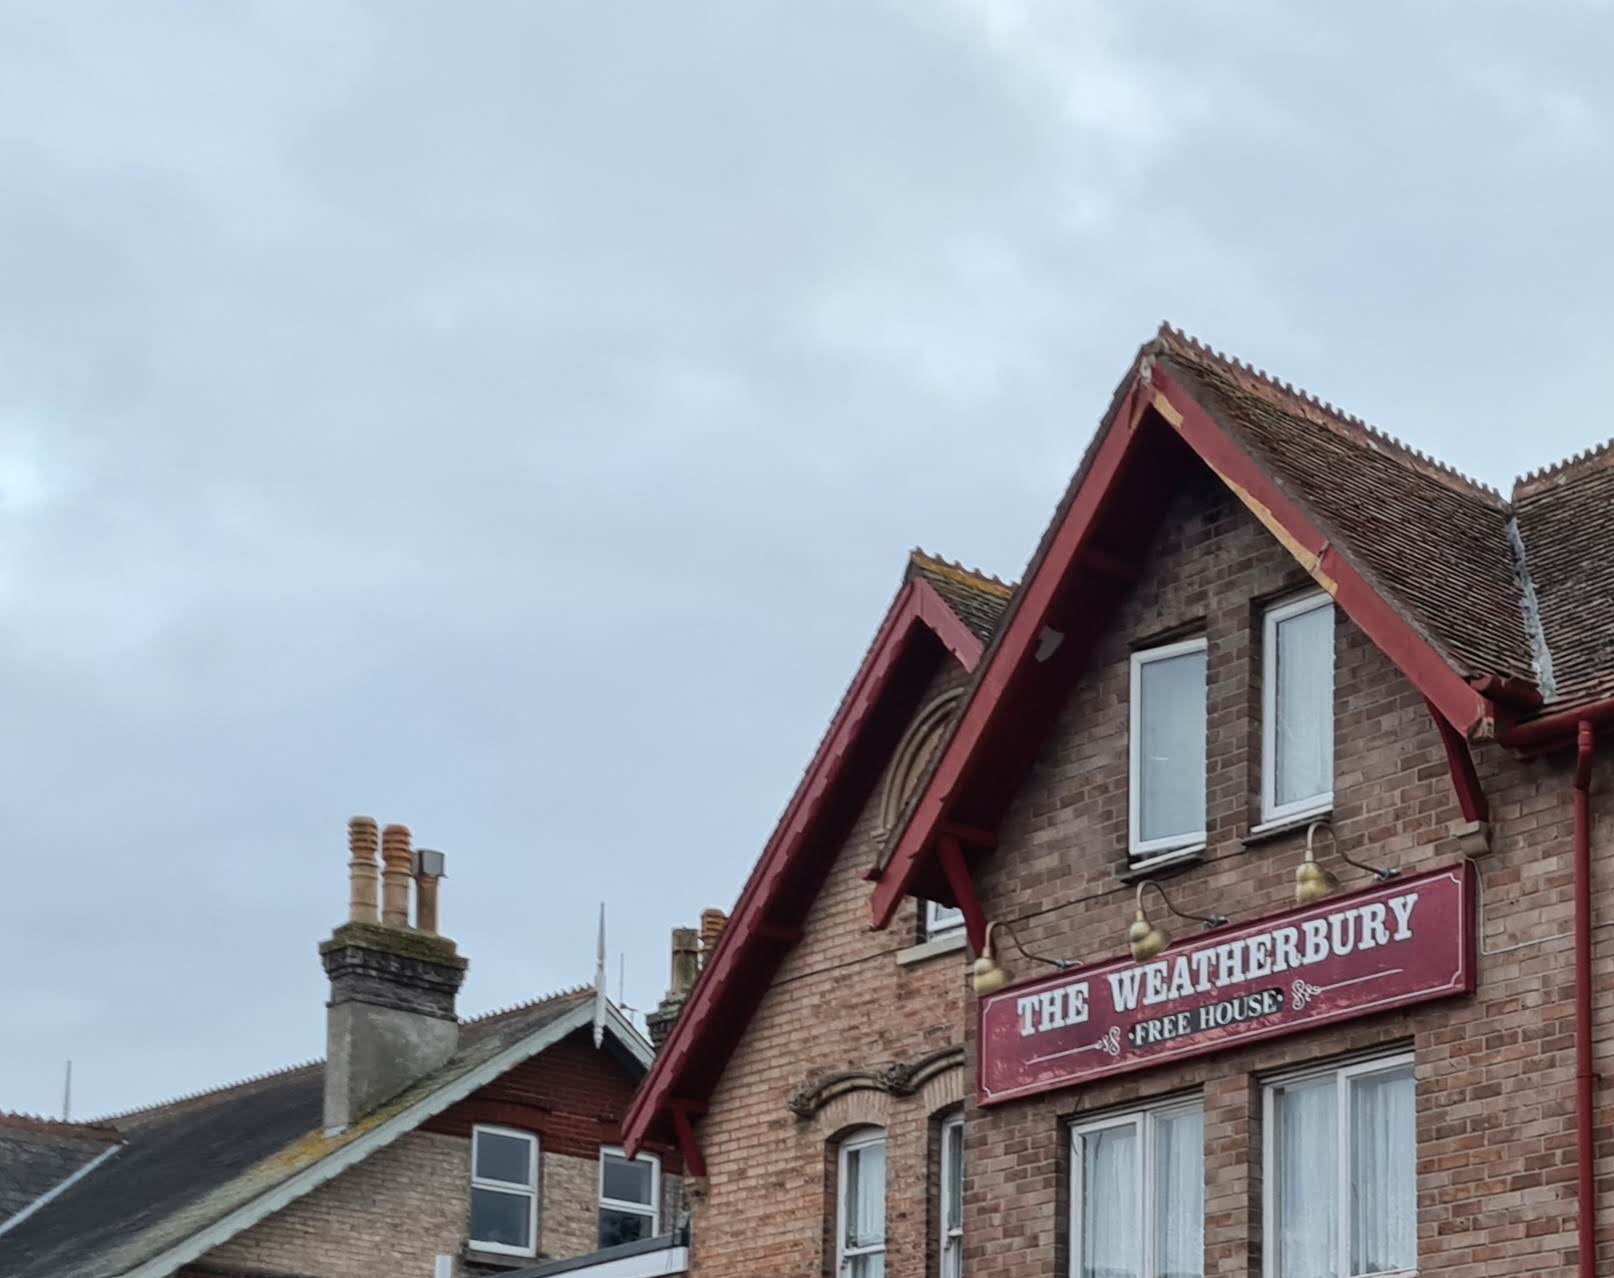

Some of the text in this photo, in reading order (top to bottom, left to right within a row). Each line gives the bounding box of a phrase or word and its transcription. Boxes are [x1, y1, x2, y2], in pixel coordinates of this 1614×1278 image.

[1016, 893, 1419, 1037] THE WEATHERBURY
[1134, 988, 1278, 1047] FREE HOUSE
